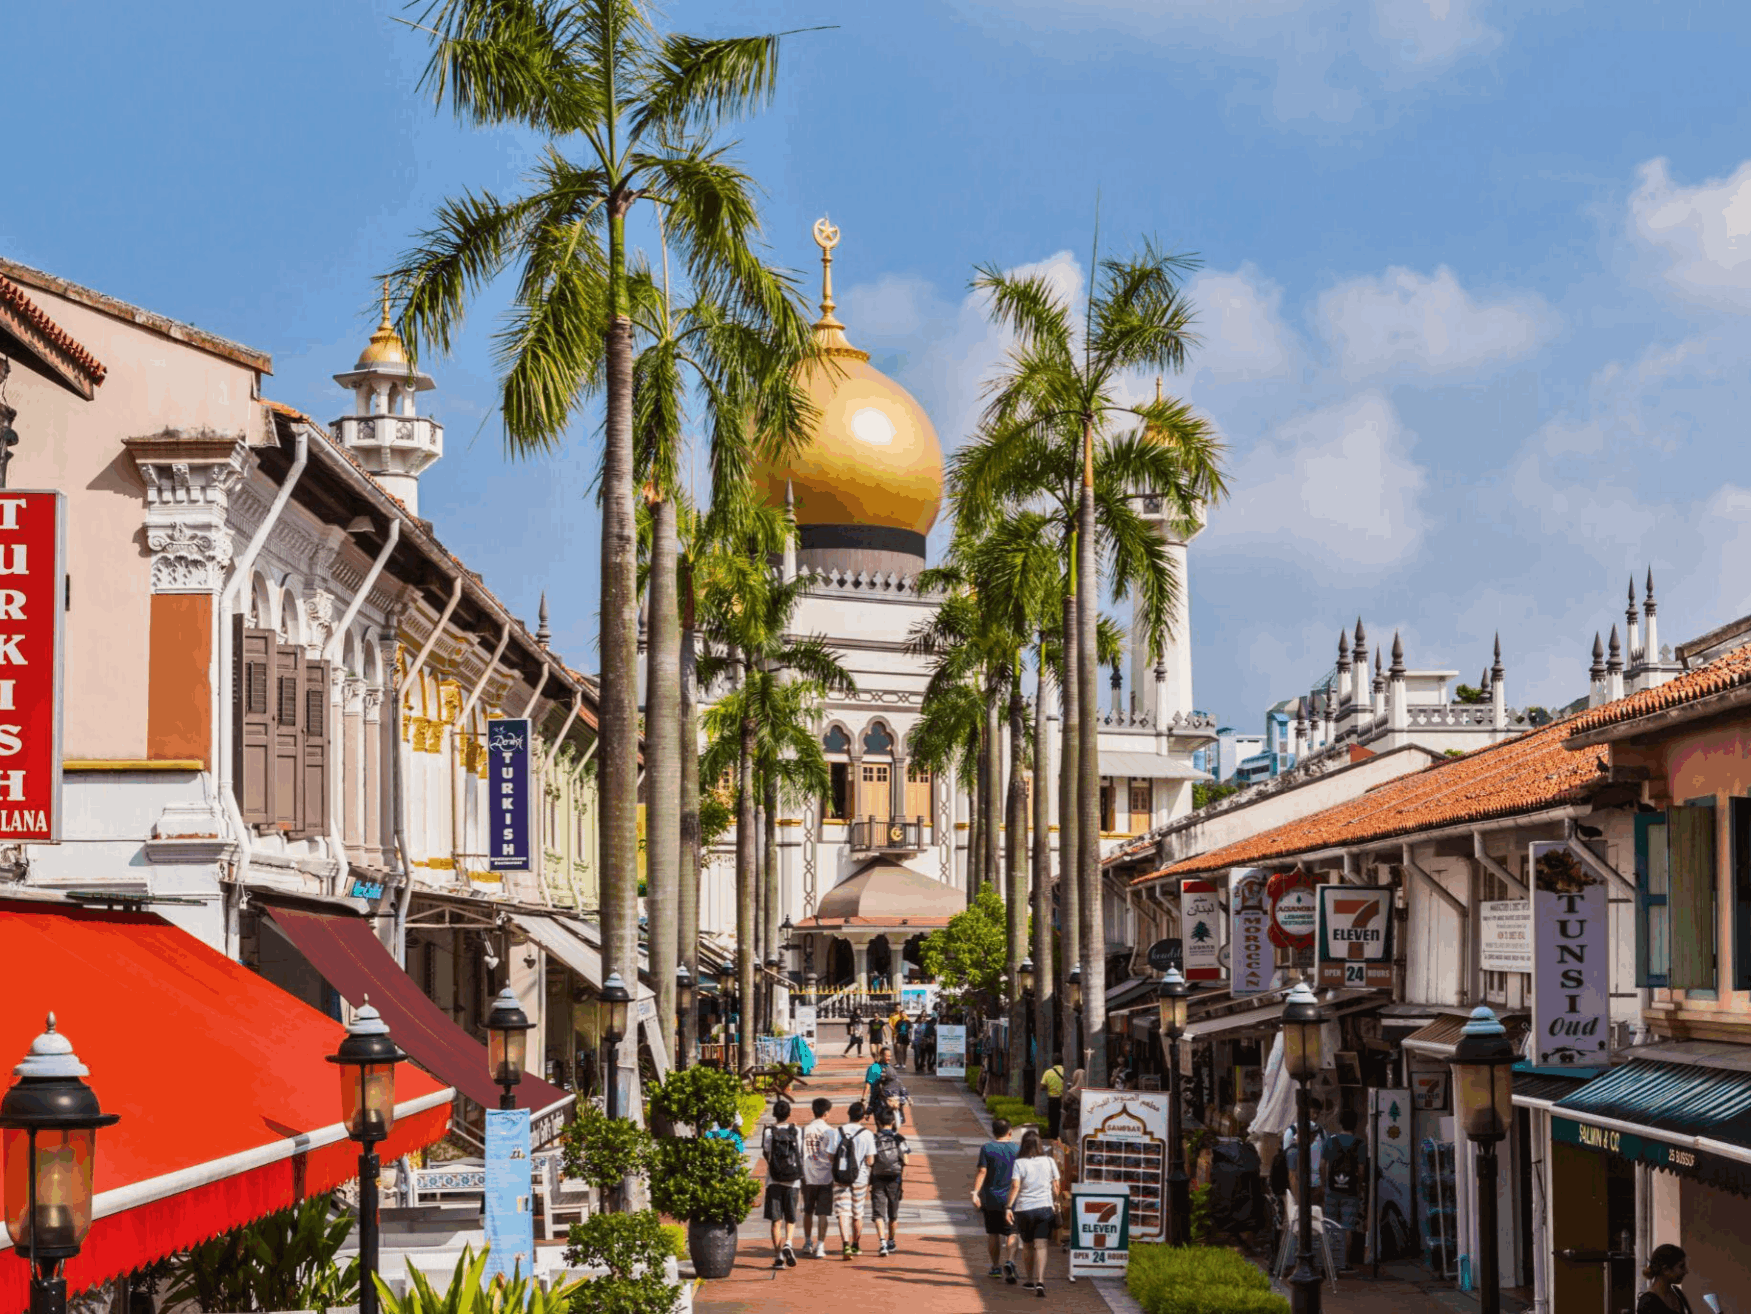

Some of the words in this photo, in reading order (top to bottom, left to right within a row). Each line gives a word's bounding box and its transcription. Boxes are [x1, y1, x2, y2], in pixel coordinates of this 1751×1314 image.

[0, 498, 29, 802] TURKISH
[501, 752, 515, 855] TURKISH
[1187, 903, 1215, 916] لبنان
[1556, 894, 1588, 1014] TUNSI
[1324, 968, 1341, 977] OPEN
[1346, 966, 1364, 982] 24
[1367, 969, 1390, 978] HOURS
[1548, 1017, 1600, 1036] Oud
[1092, 1251, 1106, 1263] 24
[1107, 1252, 1128, 1260] HOURS
